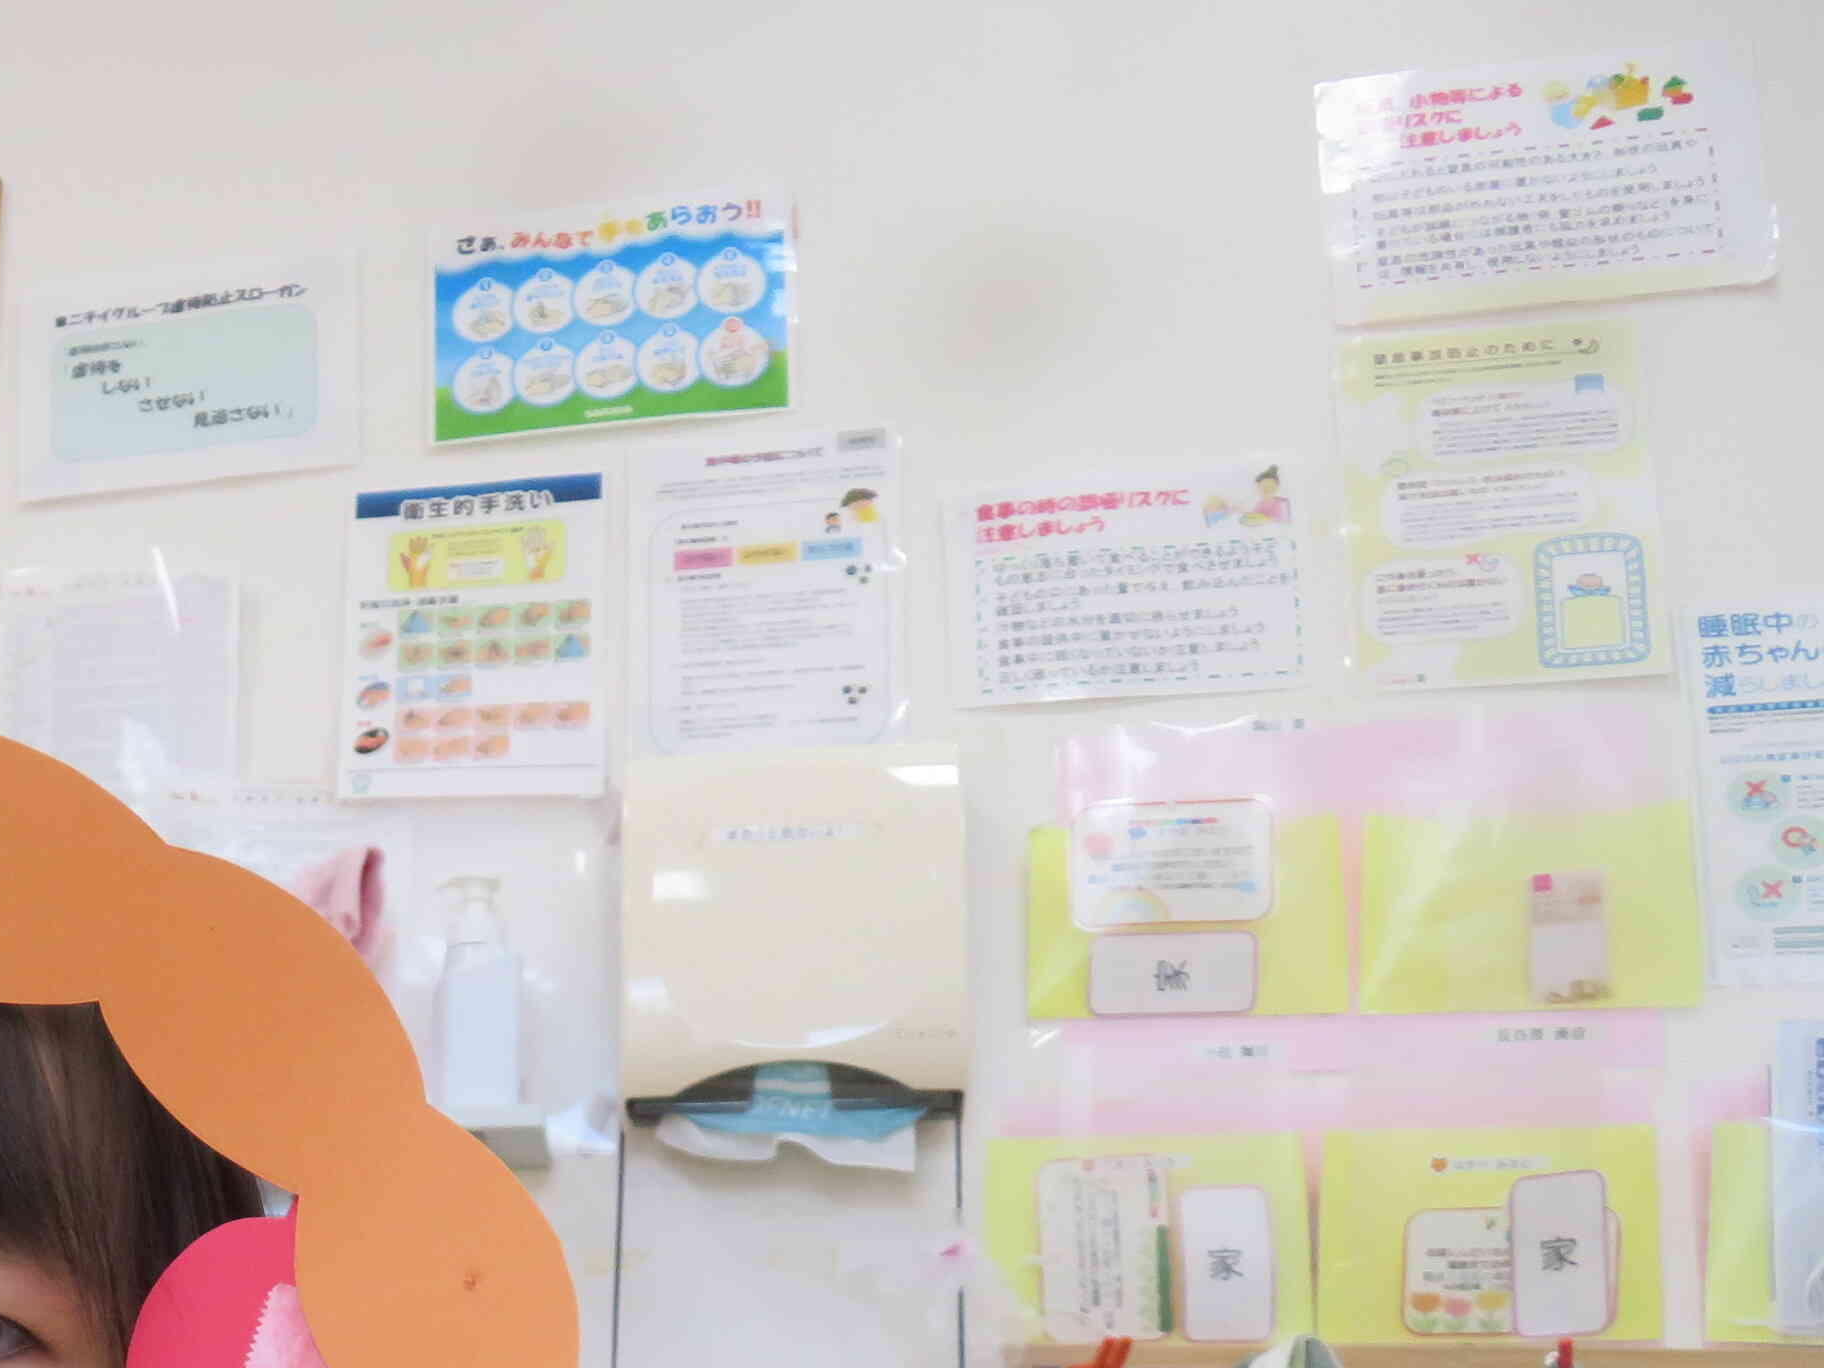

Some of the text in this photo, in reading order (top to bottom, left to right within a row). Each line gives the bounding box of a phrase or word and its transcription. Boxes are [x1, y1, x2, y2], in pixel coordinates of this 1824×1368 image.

[403, 489, 554, 520] 衛生的手洗い
[976, 515, 1105, 545] 注意しましょう
